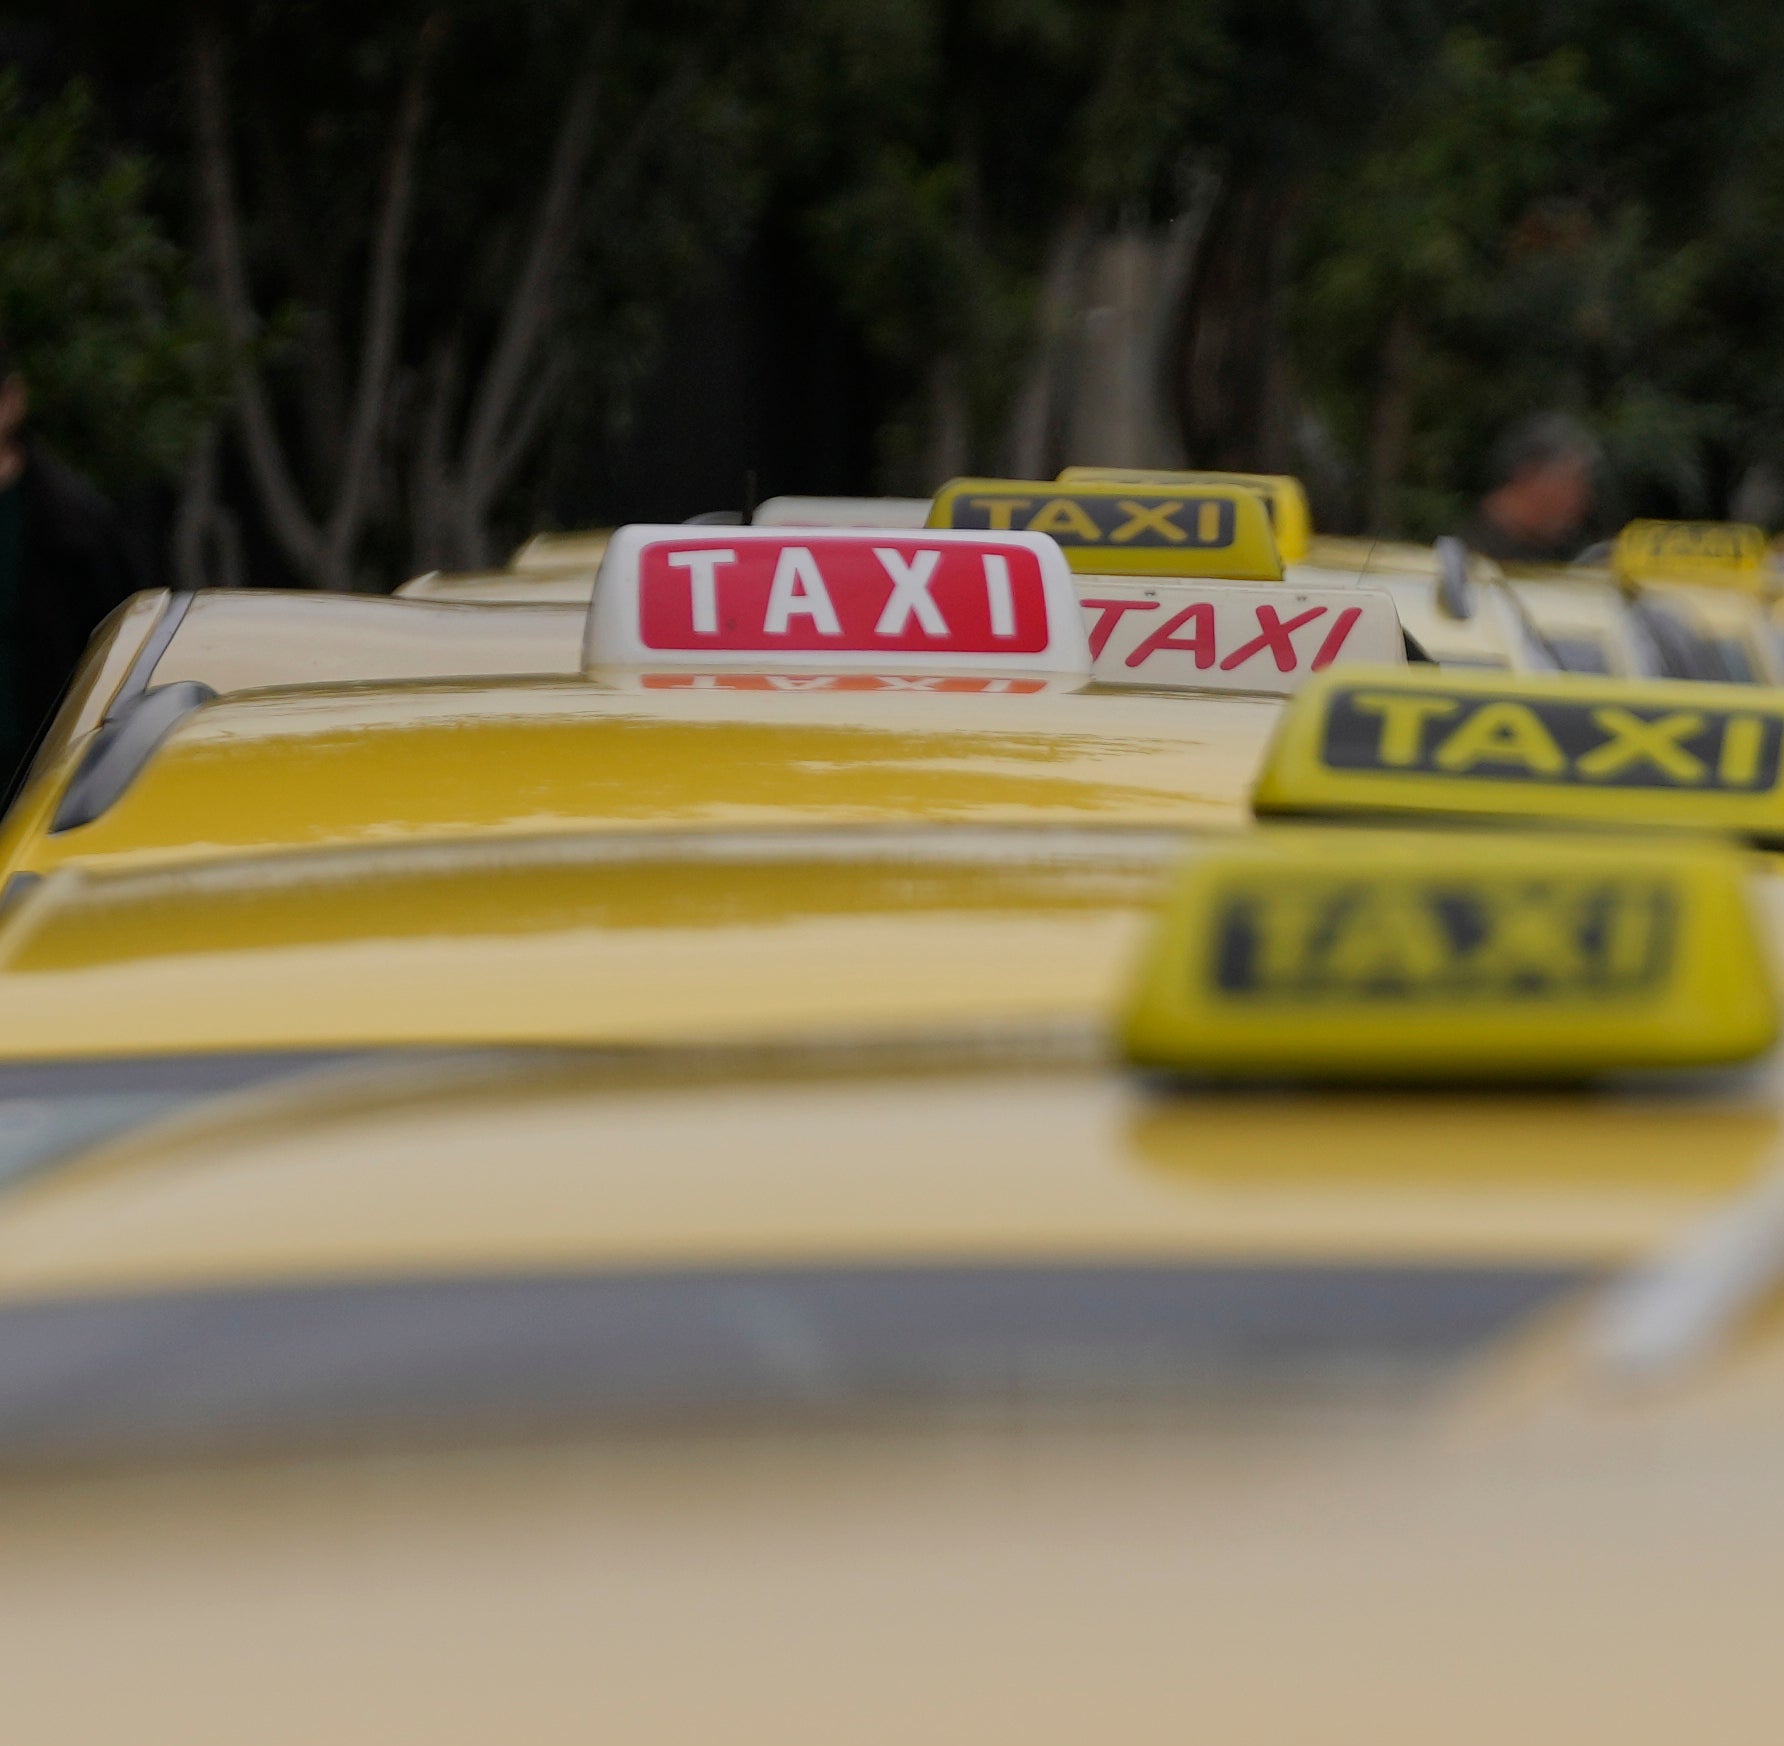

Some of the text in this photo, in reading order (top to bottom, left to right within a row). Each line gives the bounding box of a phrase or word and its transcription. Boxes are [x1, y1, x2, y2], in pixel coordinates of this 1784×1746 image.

[970, 498, 1221, 544] TAXI
[668, 546, 1017, 637] TAXI
[1080, 597, 1363, 673] TAXI
[1352, 697, 1766, 786] TAXI
[1222, 880, 1665, 992] TAXI
